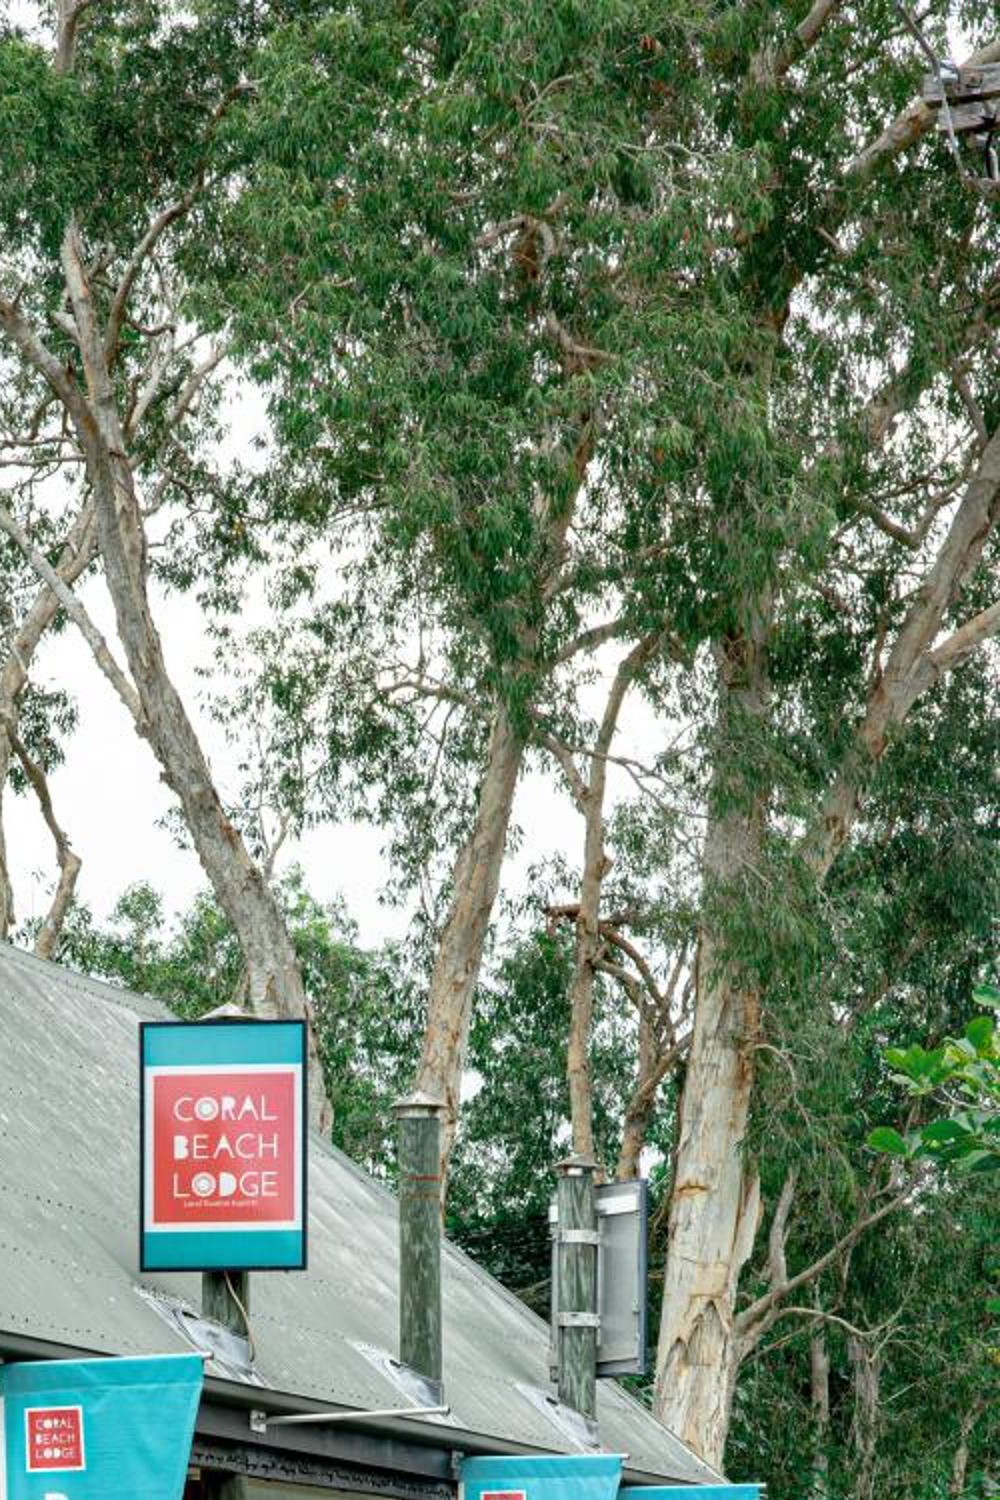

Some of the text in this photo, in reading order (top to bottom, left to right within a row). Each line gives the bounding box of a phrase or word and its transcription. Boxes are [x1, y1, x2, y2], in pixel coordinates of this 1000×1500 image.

[173, 1095, 278, 1121] CORAL
[173, 1132, 278, 1159] BEACH
[173, 1171, 279, 1199] LODGE
[35, 1418, 73, 1430] CORAL
[35, 1433, 75, 1445] BEACH
[35, 1447, 74, 1459] LODGE
